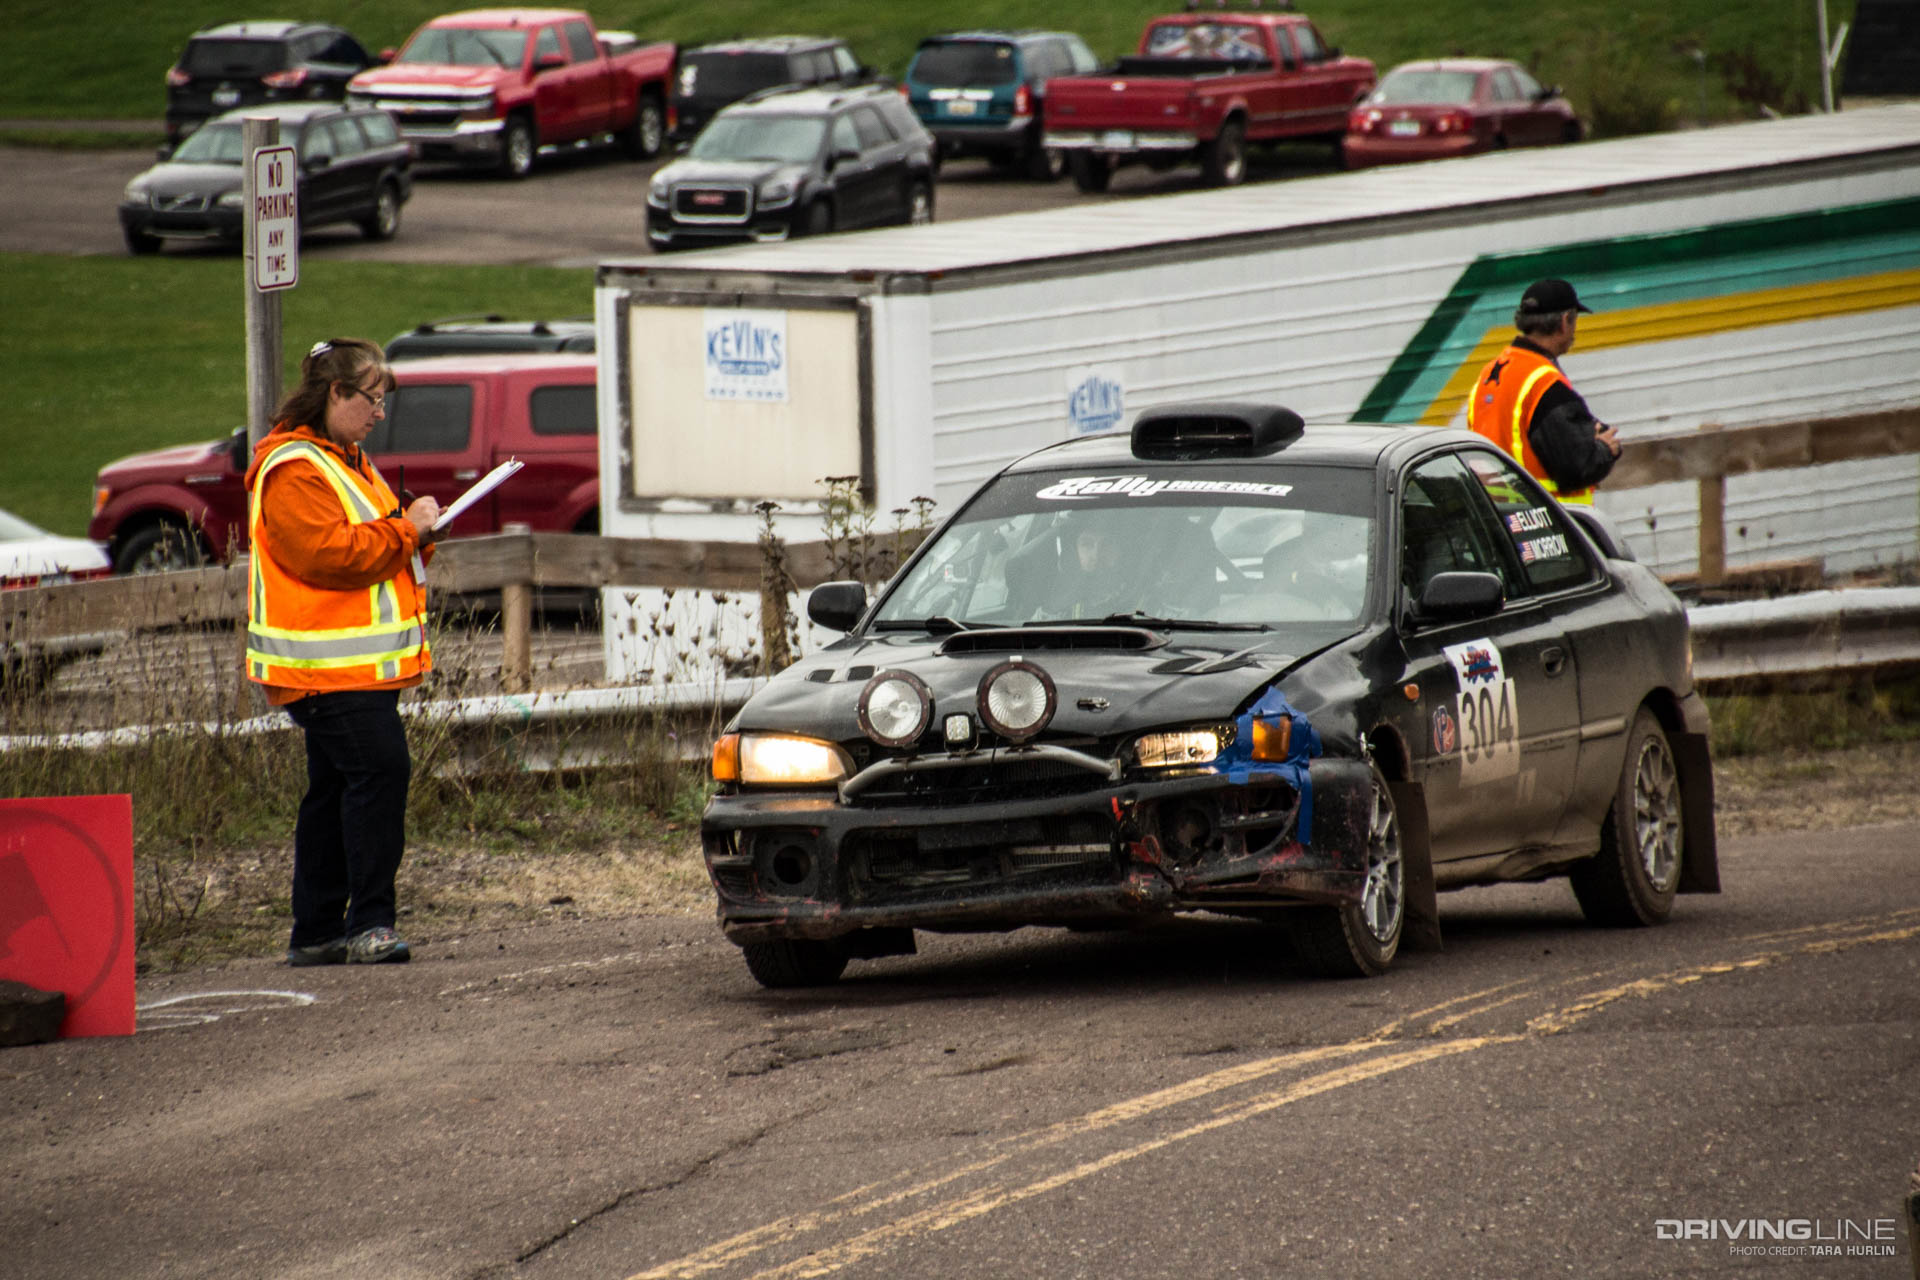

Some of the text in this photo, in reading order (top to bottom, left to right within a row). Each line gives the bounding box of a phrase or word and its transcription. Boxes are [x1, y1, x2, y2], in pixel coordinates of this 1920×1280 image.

[268, 162, 282, 188] NO
[258, 192, 294, 221] PARKING
[268, 230, 284, 248] ANY
[267, 254, 286, 273] TIME
[706, 319, 783, 371] KEVIN'S
[1036, 475, 1293, 500] Rally AMERICA
[1515, 506, 1553, 532] ELLIOTT
[1529, 534, 1569, 560] MORROW
[1462, 681, 1514, 765] 304
